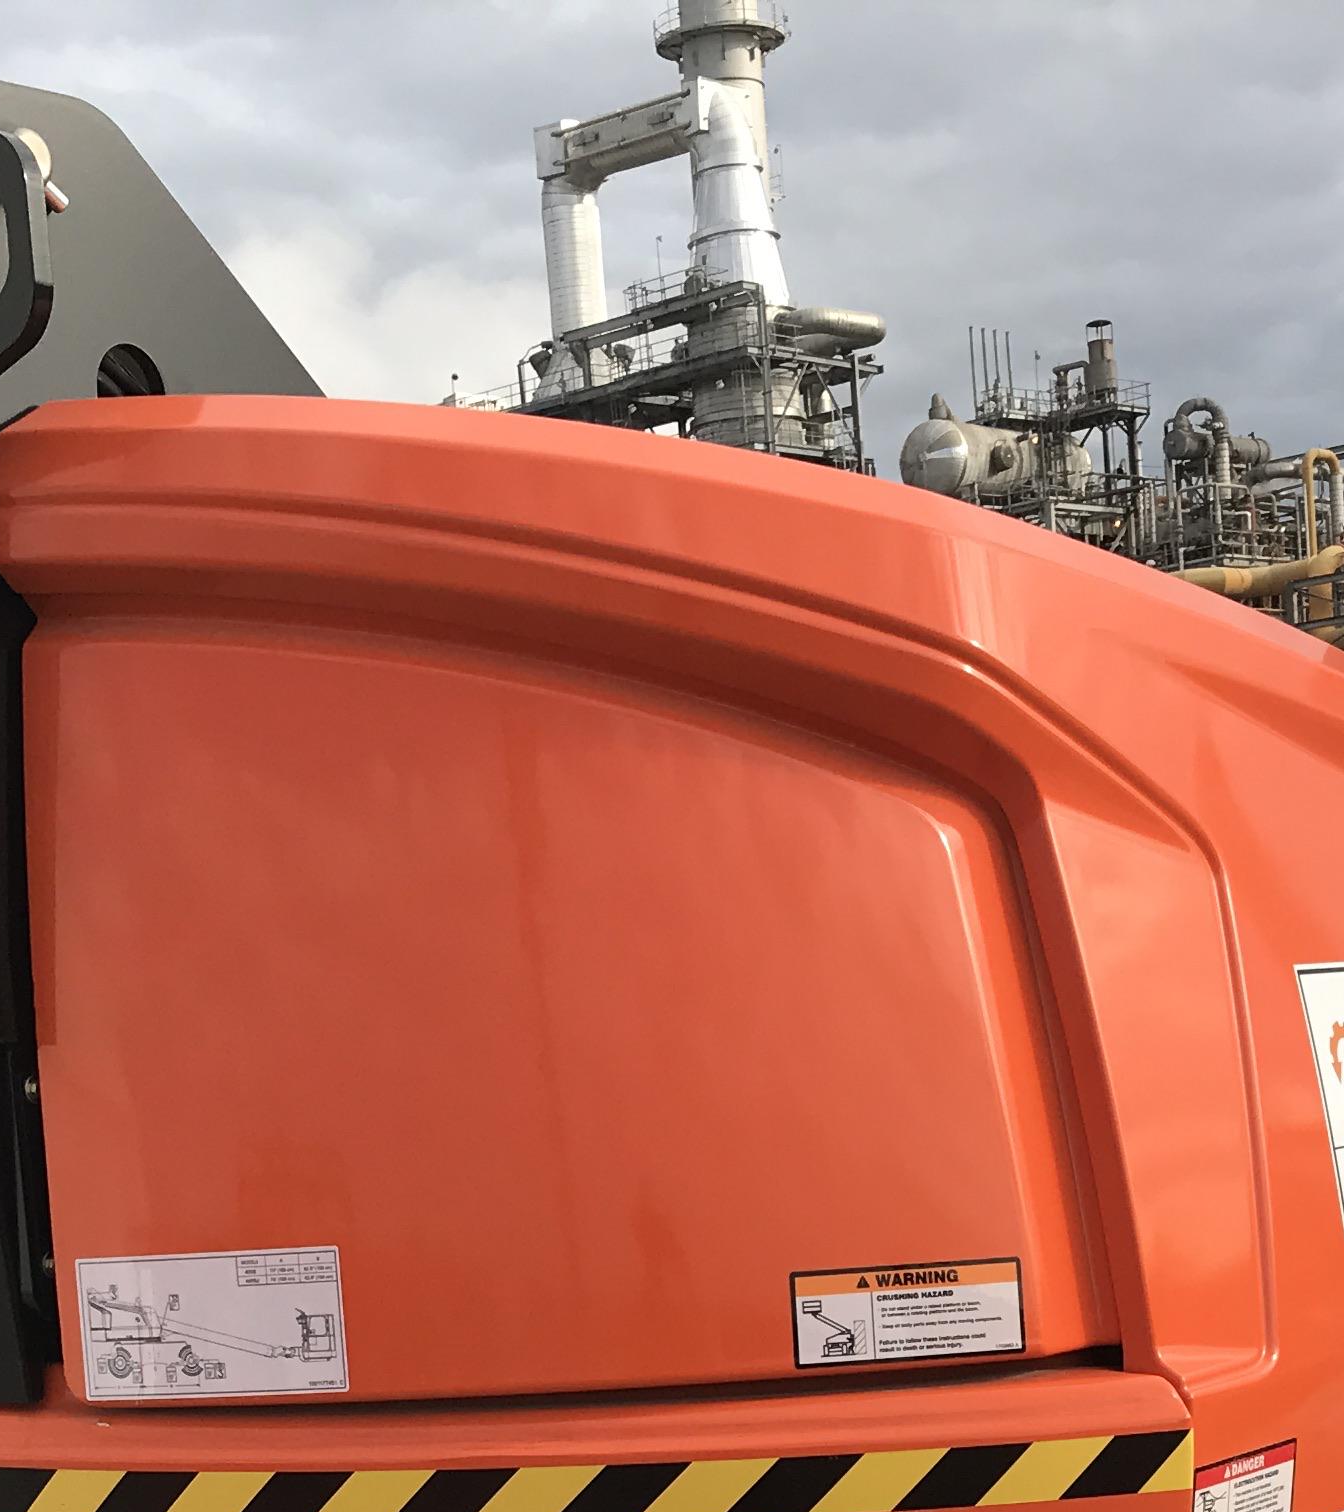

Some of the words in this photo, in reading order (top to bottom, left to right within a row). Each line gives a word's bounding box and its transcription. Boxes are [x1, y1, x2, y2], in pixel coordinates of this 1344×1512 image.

[875, 1269, 959, 1288] WARNING
[876, 1292, 919, 1302] CRUSHING
[921, 1290, 954, 1299] HAZARD
[1231, 1454, 1265, 1476] DANGER
